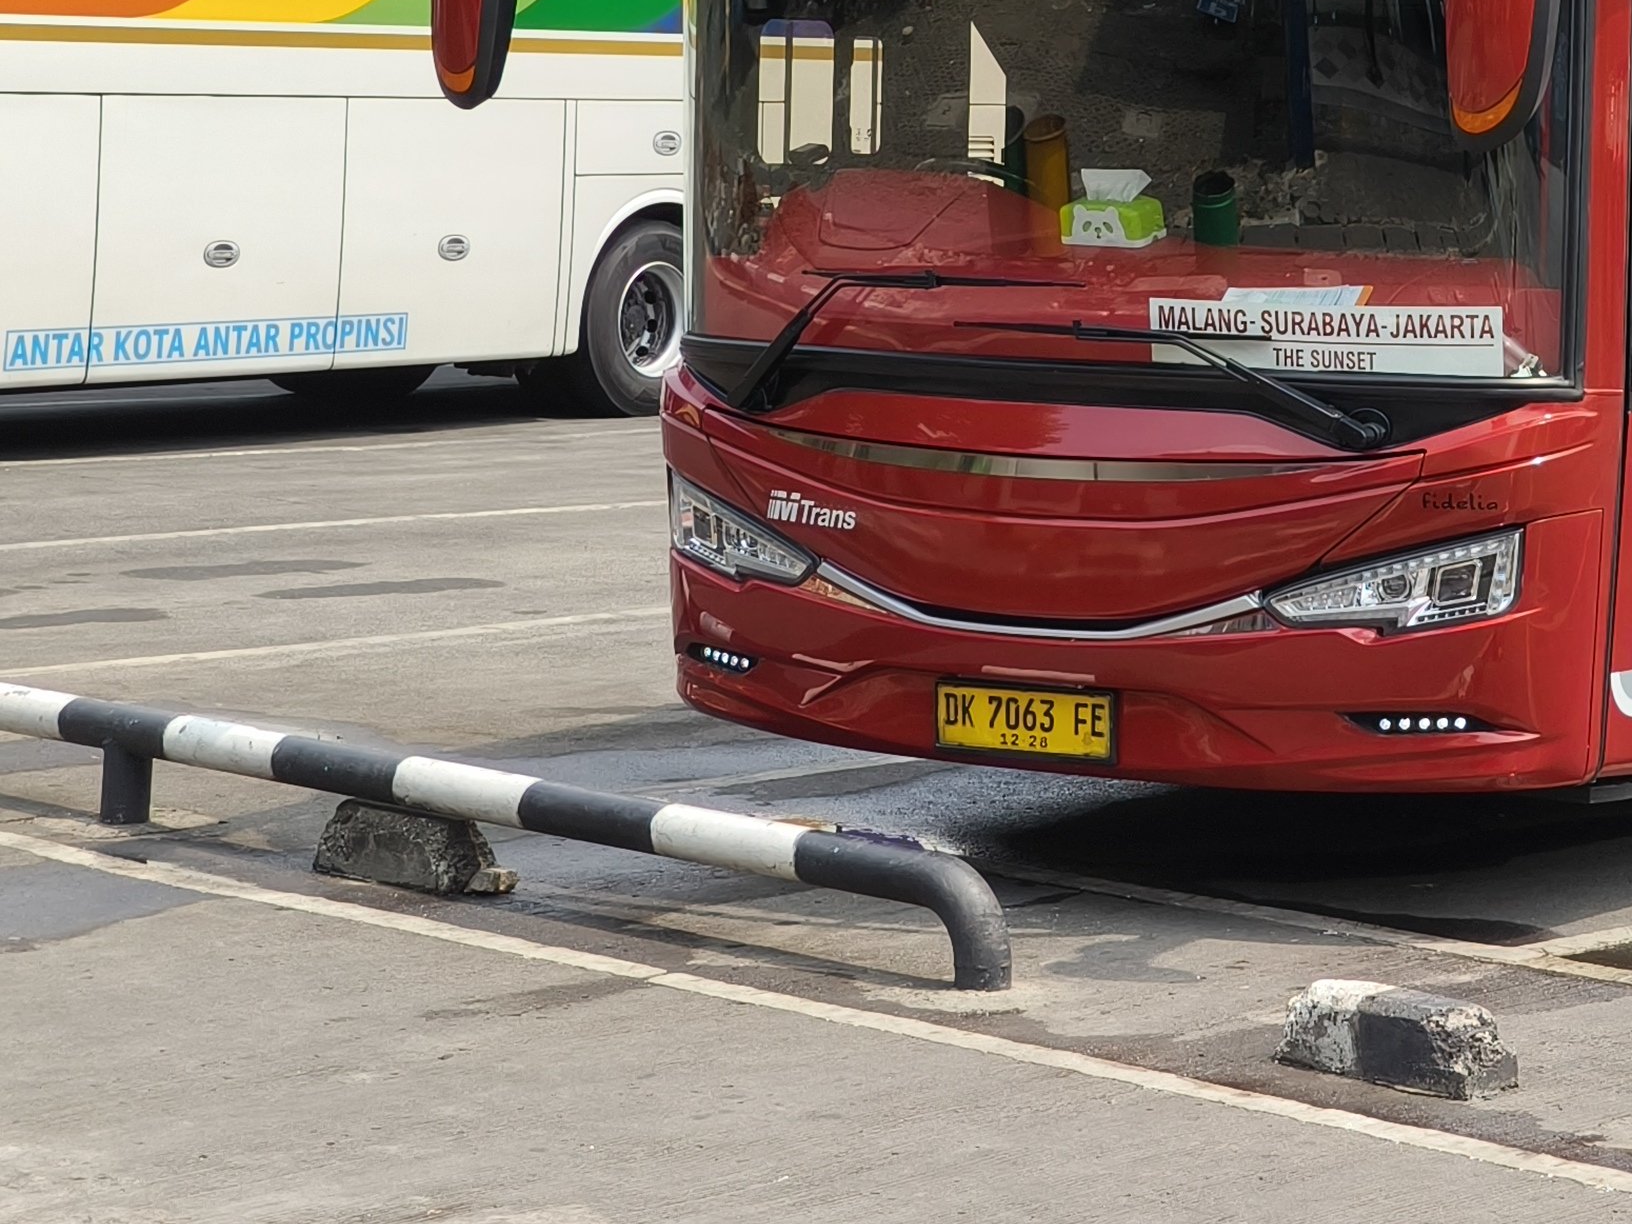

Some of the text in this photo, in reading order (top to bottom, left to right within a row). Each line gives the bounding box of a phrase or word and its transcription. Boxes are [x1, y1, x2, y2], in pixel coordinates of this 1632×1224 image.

[8, 316, 405, 367] ANTAR KOTA ANTAR PROPINSI
[1272, 346, 1377, 372] THE SUNSET
[943, 692, 1106, 739] DK 7063 FE
